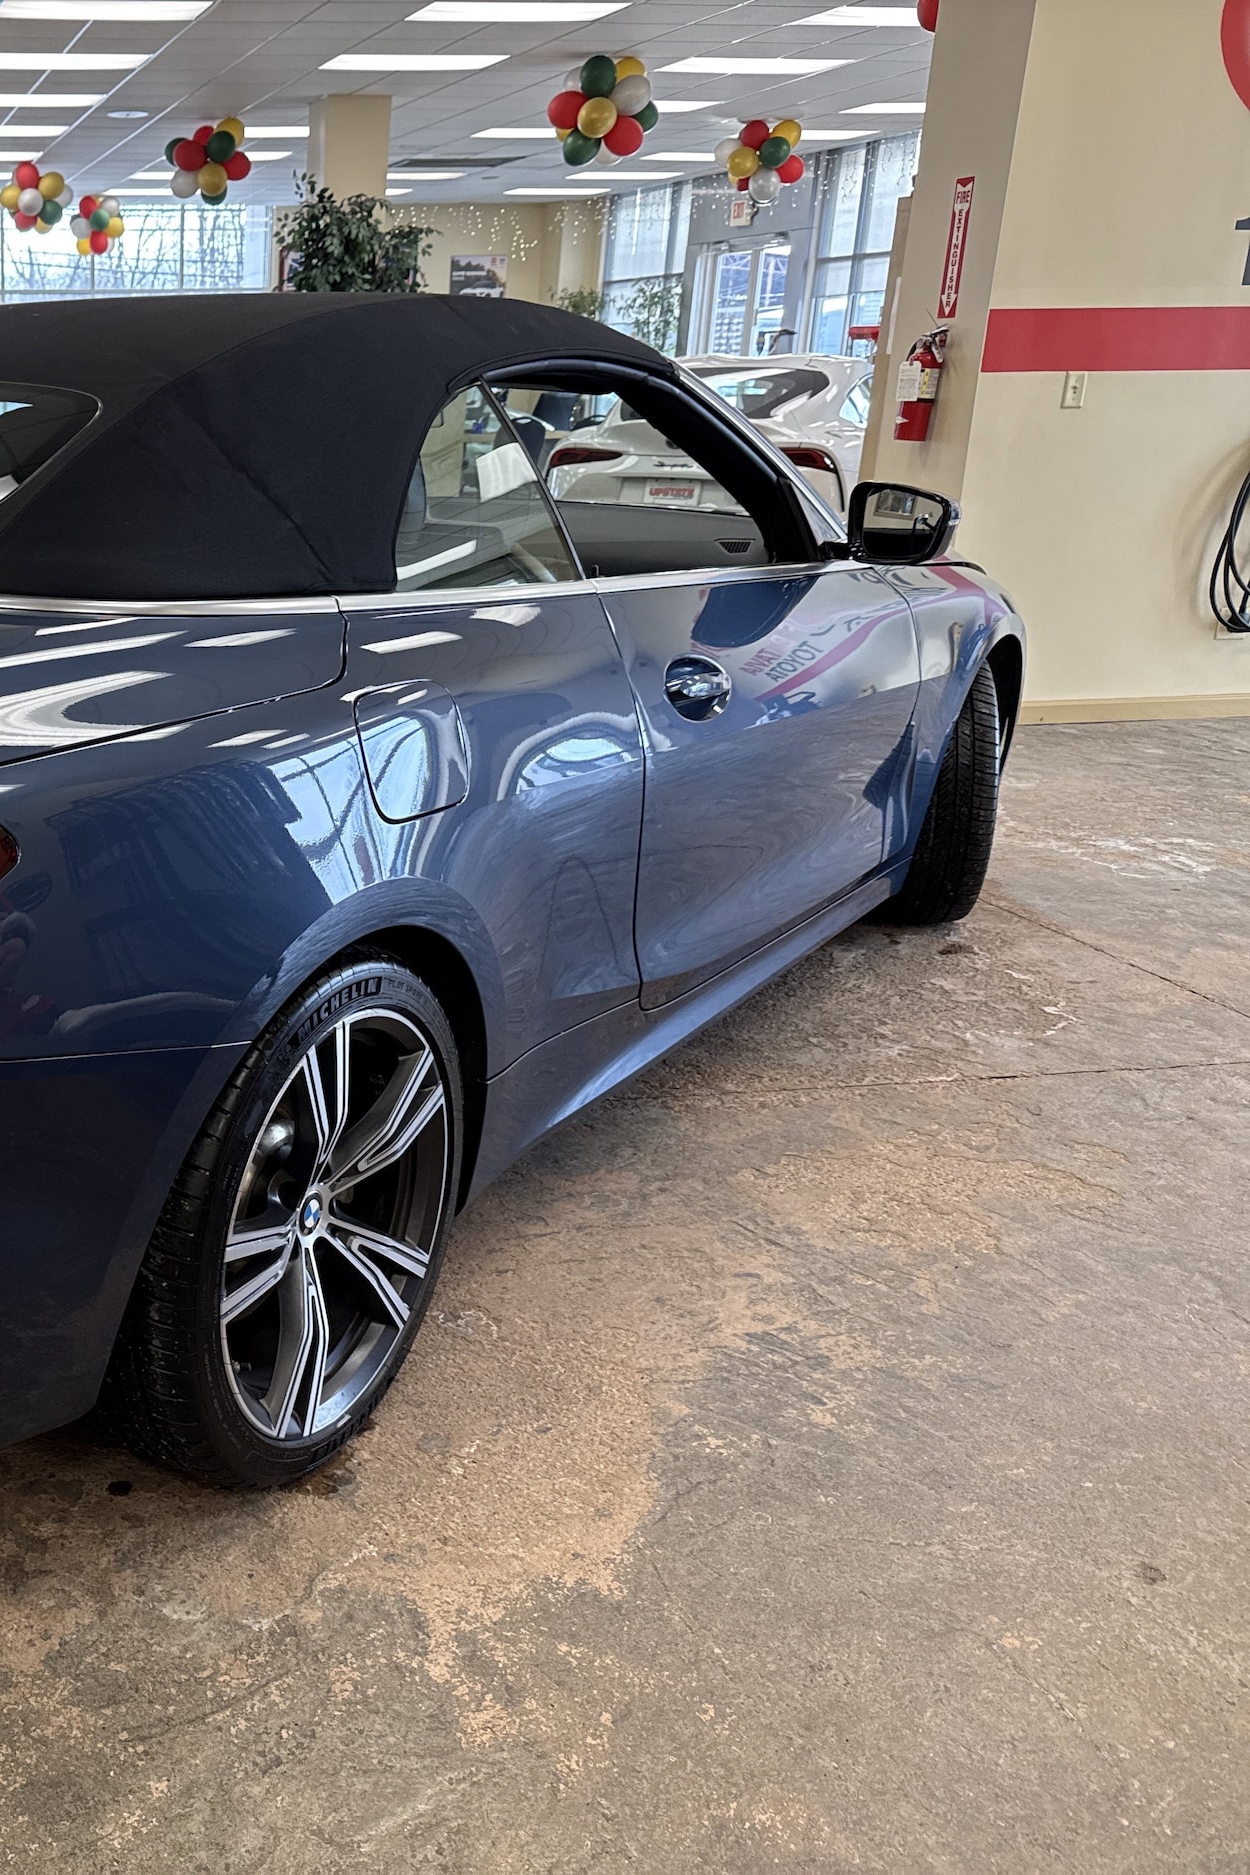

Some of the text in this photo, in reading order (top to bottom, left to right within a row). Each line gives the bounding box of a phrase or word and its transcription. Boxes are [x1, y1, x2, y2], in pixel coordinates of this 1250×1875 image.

[956, 190, 970, 204] FIRE
[945, 208, 964, 308] EXTINGUISHER
[297, 977, 423, 1042] MICHELIN PILOT SPORT
